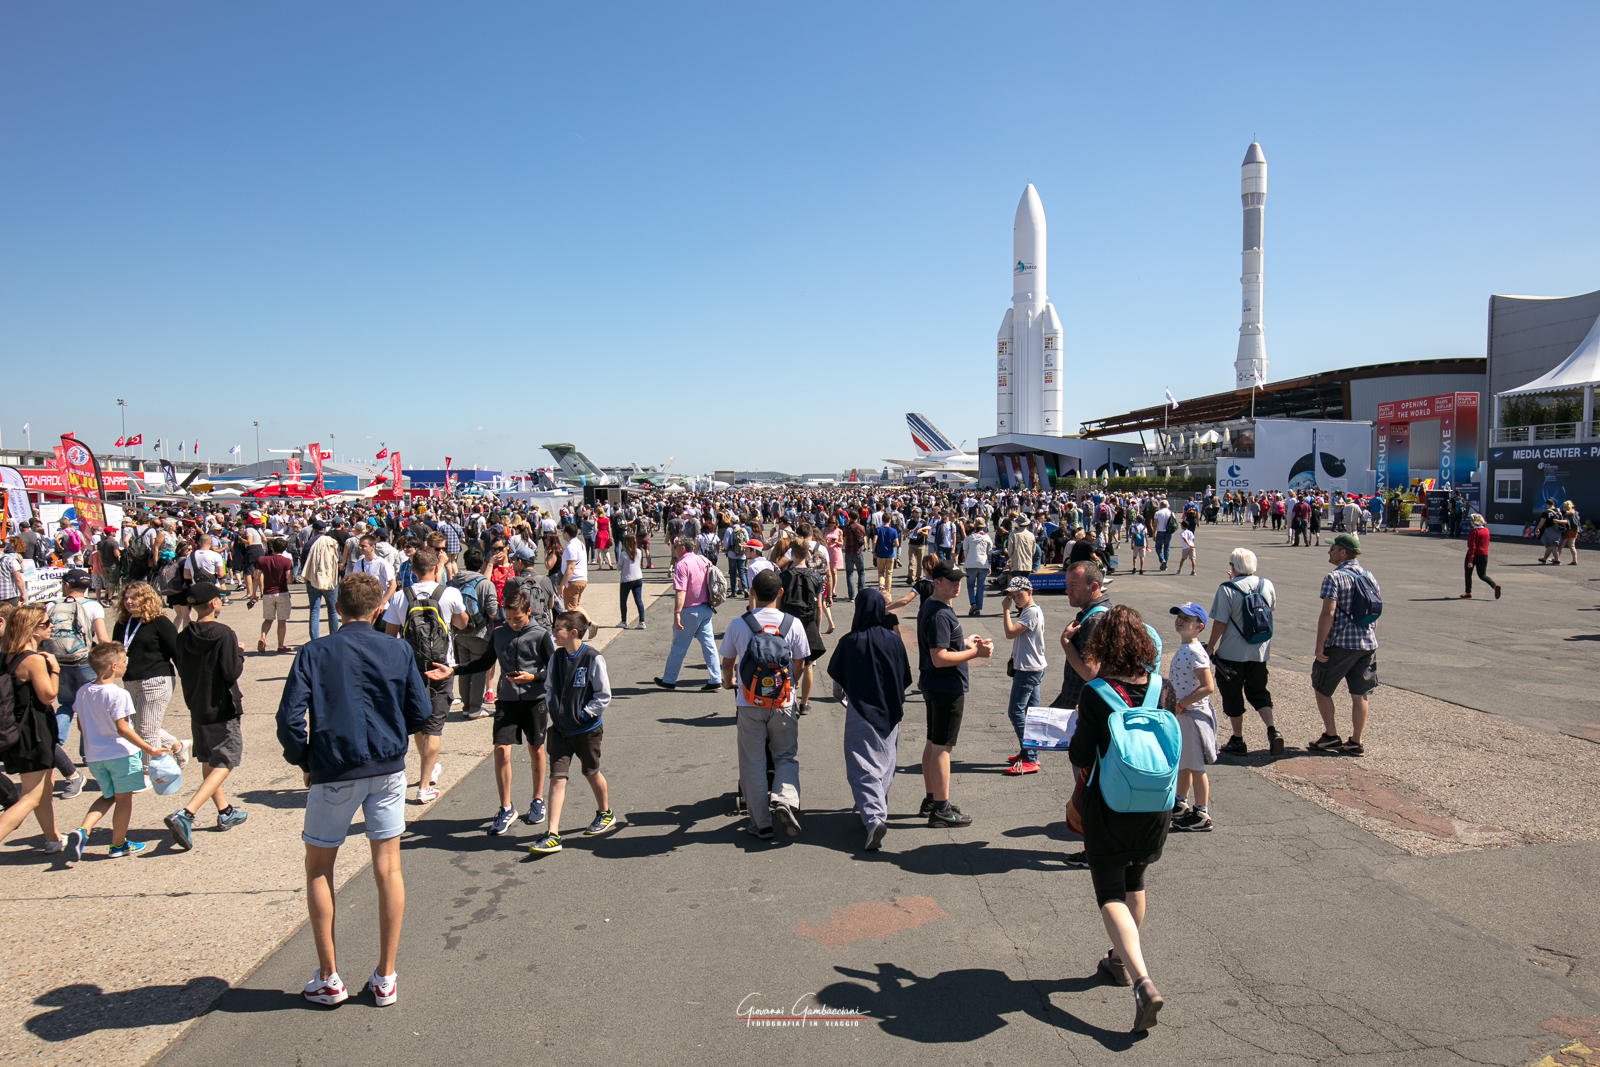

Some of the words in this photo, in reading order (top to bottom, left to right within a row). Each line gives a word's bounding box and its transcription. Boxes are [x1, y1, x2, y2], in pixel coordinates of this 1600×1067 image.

[1401, 399, 1428, 410] OPENING
[1410, 408, 1431, 417] WORLD
[1512, 449, 1541, 459] MEDIA
[1543, 447, 1581, 458] CENTER
[23, 475, 62, 486] EONARDO
[1219, 479, 1249, 487] cnes
